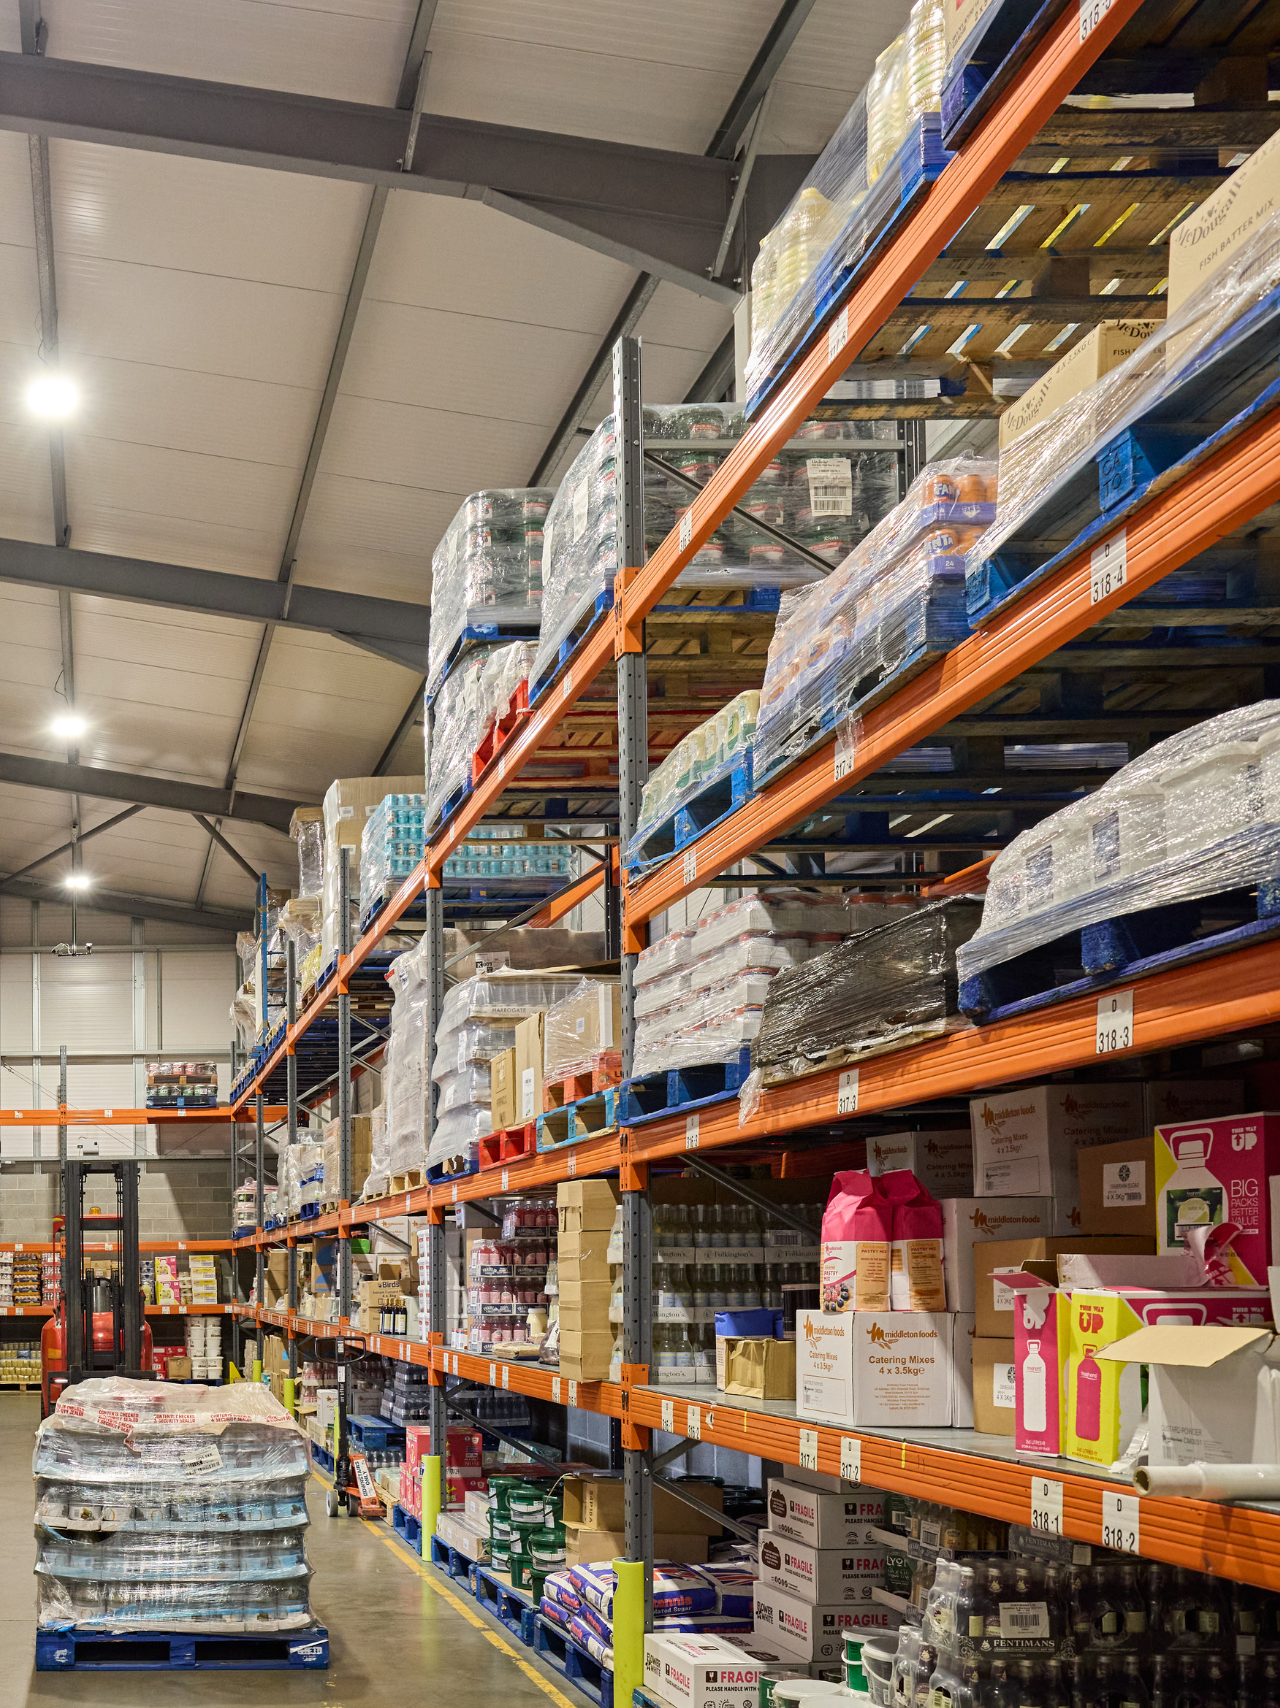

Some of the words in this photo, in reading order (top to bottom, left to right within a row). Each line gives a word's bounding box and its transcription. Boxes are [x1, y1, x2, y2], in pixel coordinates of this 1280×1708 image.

[1198, 250, 1218, 271] FISH
[1219, 218, 1254, 253] BATTER
[1255, 198, 1275, 220] MIX
[1111, 999, 1117, 1012] D
[994, 1108, 1020, 1121] middleton
[1020, 1104, 1036, 1116] foods
[1063, 1127, 1101, 1137] Catering
[1103, 1126, 1129, 1135] Mixes
[990, 1136, 1011, 1147] Catering
[1011, 1132, 1028, 1143] Mixes
[1231, 1132, 1258, 1152] UP
[1230, 1178, 1259, 1198] BIG
[1230, 1197, 1259, 1207] PACKS
[1231, 1207, 1259, 1216] BETTER
[987, 1215, 1021, 1224] middleton
[1021, 1214, 1041, 1223] foods
[1231, 1216, 1259, 1226] VALUE
[1079, 1304, 1091, 1312] THIS
[1093, 1305, 1104, 1313] WAY
[1079, 1312, 1104, 1334] UP
[813, 1325, 833, 1337] middleton
[833, 1326, 845, 1337] foods
[884, 1329, 918, 1339] middleton
[918, 1330, 937, 1338] foods
[809, 1350, 826, 1361] Catering
[826, 1352, 838, 1361] Mixes
[868, 1355, 907, 1366] Catering
[909, 1355, 935, 1364] Mixes
[879, 1366, 884, 1375] 4
[1043, 1483, 1048, 1496] D
[795, 1502, 815, 1520] FRAGILE
[1116, 1498, 1122, 1511] D
[1024, 1536, 1060, 1551] FENTIMANS
[791, 1556, 813, 1575] FRAGILE
[784, 1612, 808, 1634] FRAGILE
[838, 1614, 888, 1627] FRAGILE
[993, 1639, 1055, 1648] FENTIMANS
[671, 1667, 691, 1689] FRAGILE
